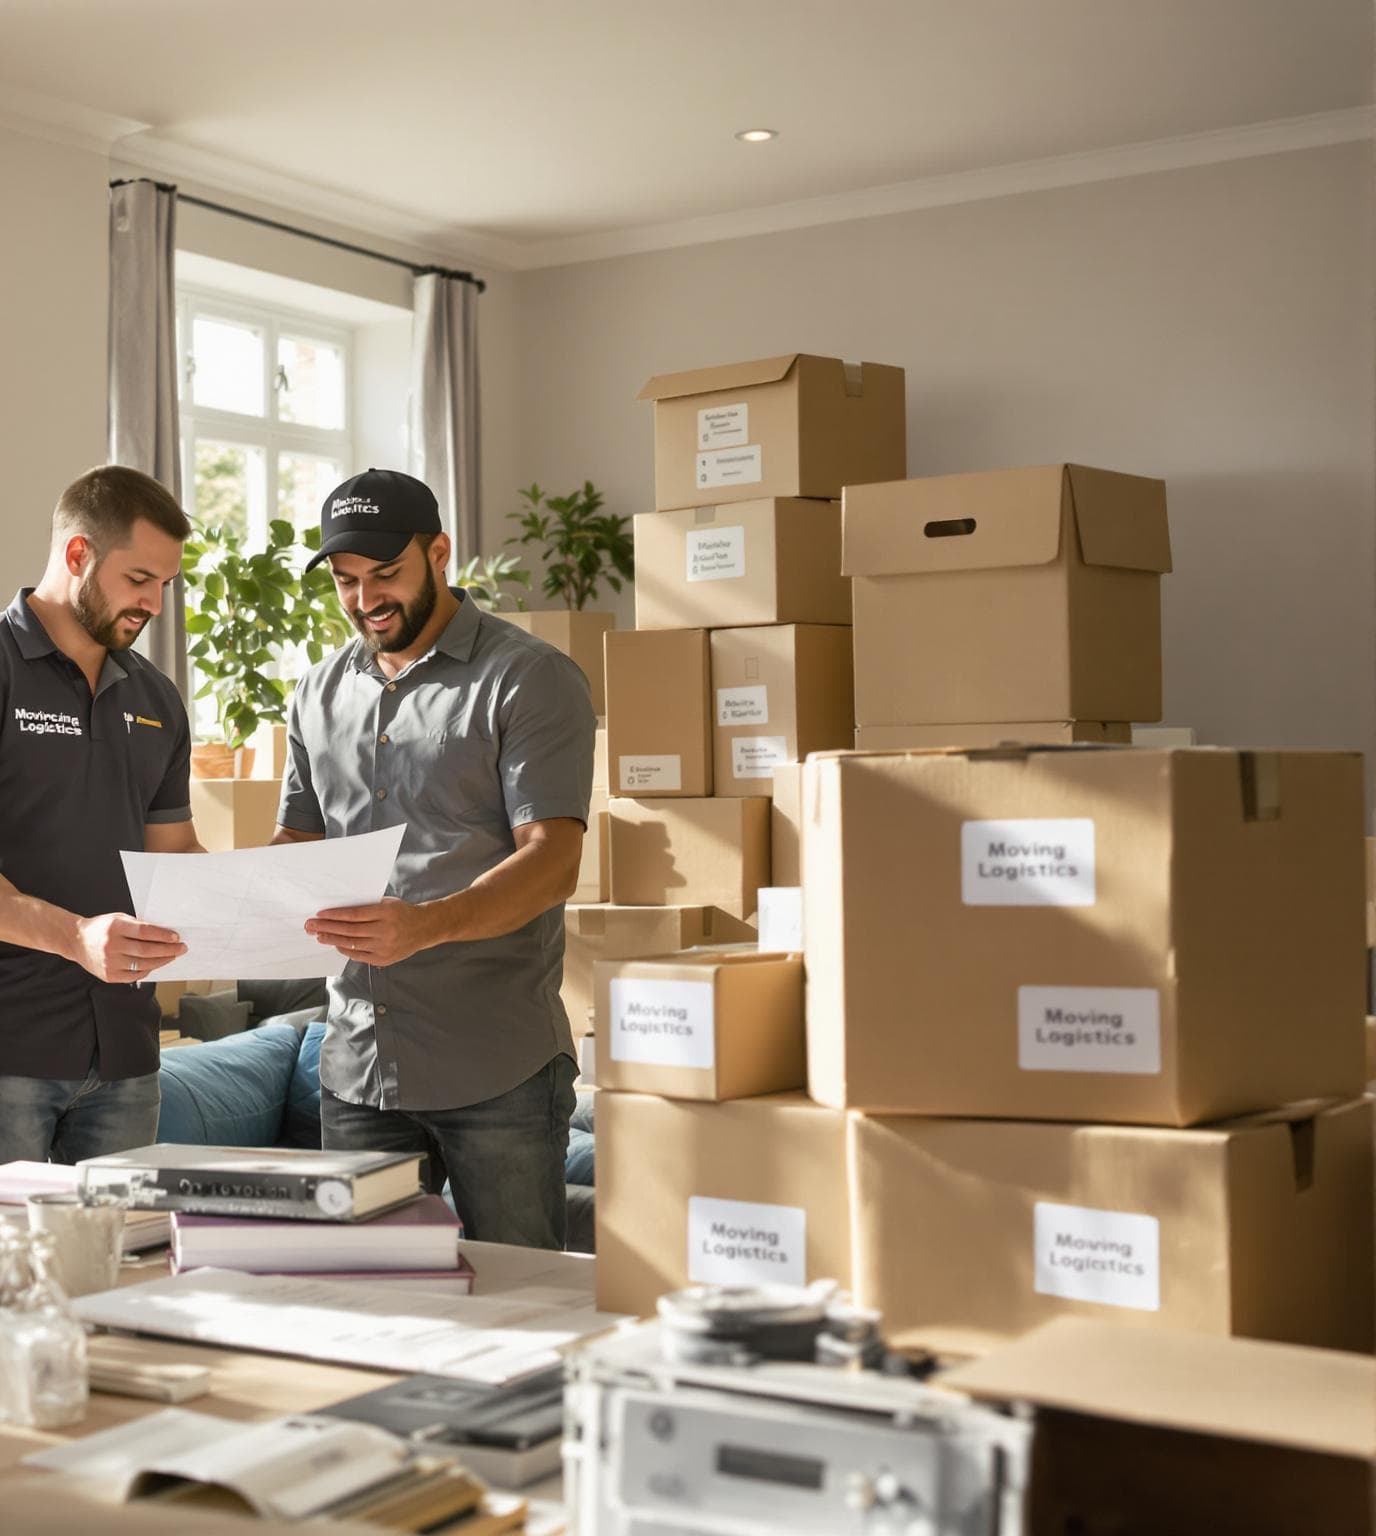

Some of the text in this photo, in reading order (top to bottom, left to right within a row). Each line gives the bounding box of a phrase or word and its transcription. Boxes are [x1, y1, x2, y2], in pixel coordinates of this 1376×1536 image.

[988, 842, 1066, 860] Moving
[978, 863, 1079, 880] Logistics
[627, 1003, 688, 1021] Moving
[1045, 1008, 1123, 1028] Moving
[1035, 1028, 1135, 1046] Logistics
[711, 1222, 780, 1246] Moving
[703, 1240, 789, 1263] Logistics
[1055, 1233, 1133, 1257] Moving
